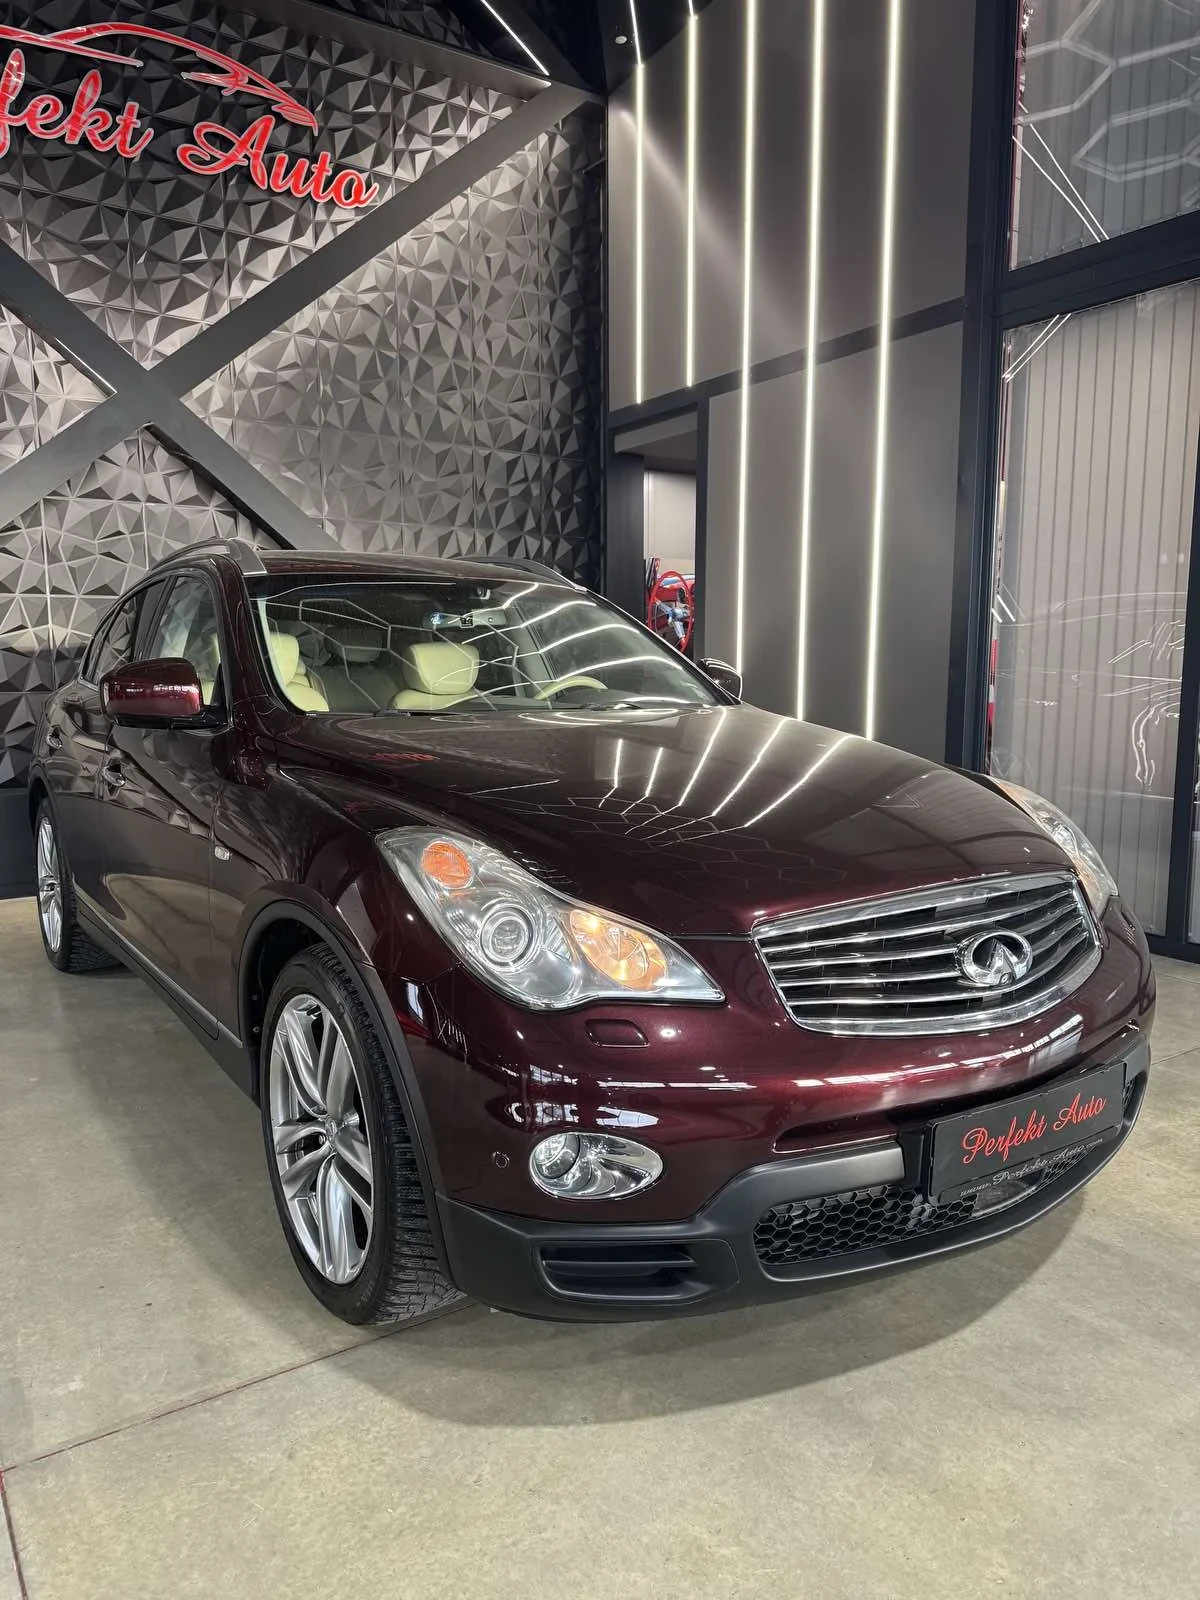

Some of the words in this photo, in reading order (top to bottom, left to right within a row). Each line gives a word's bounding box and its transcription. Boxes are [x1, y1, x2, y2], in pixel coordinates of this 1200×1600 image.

[177, 115, 379, 208] Auto
[963, 1110, 1046, 1163] Perfekt
[1053, 1093, 1107, 1131] Auto
